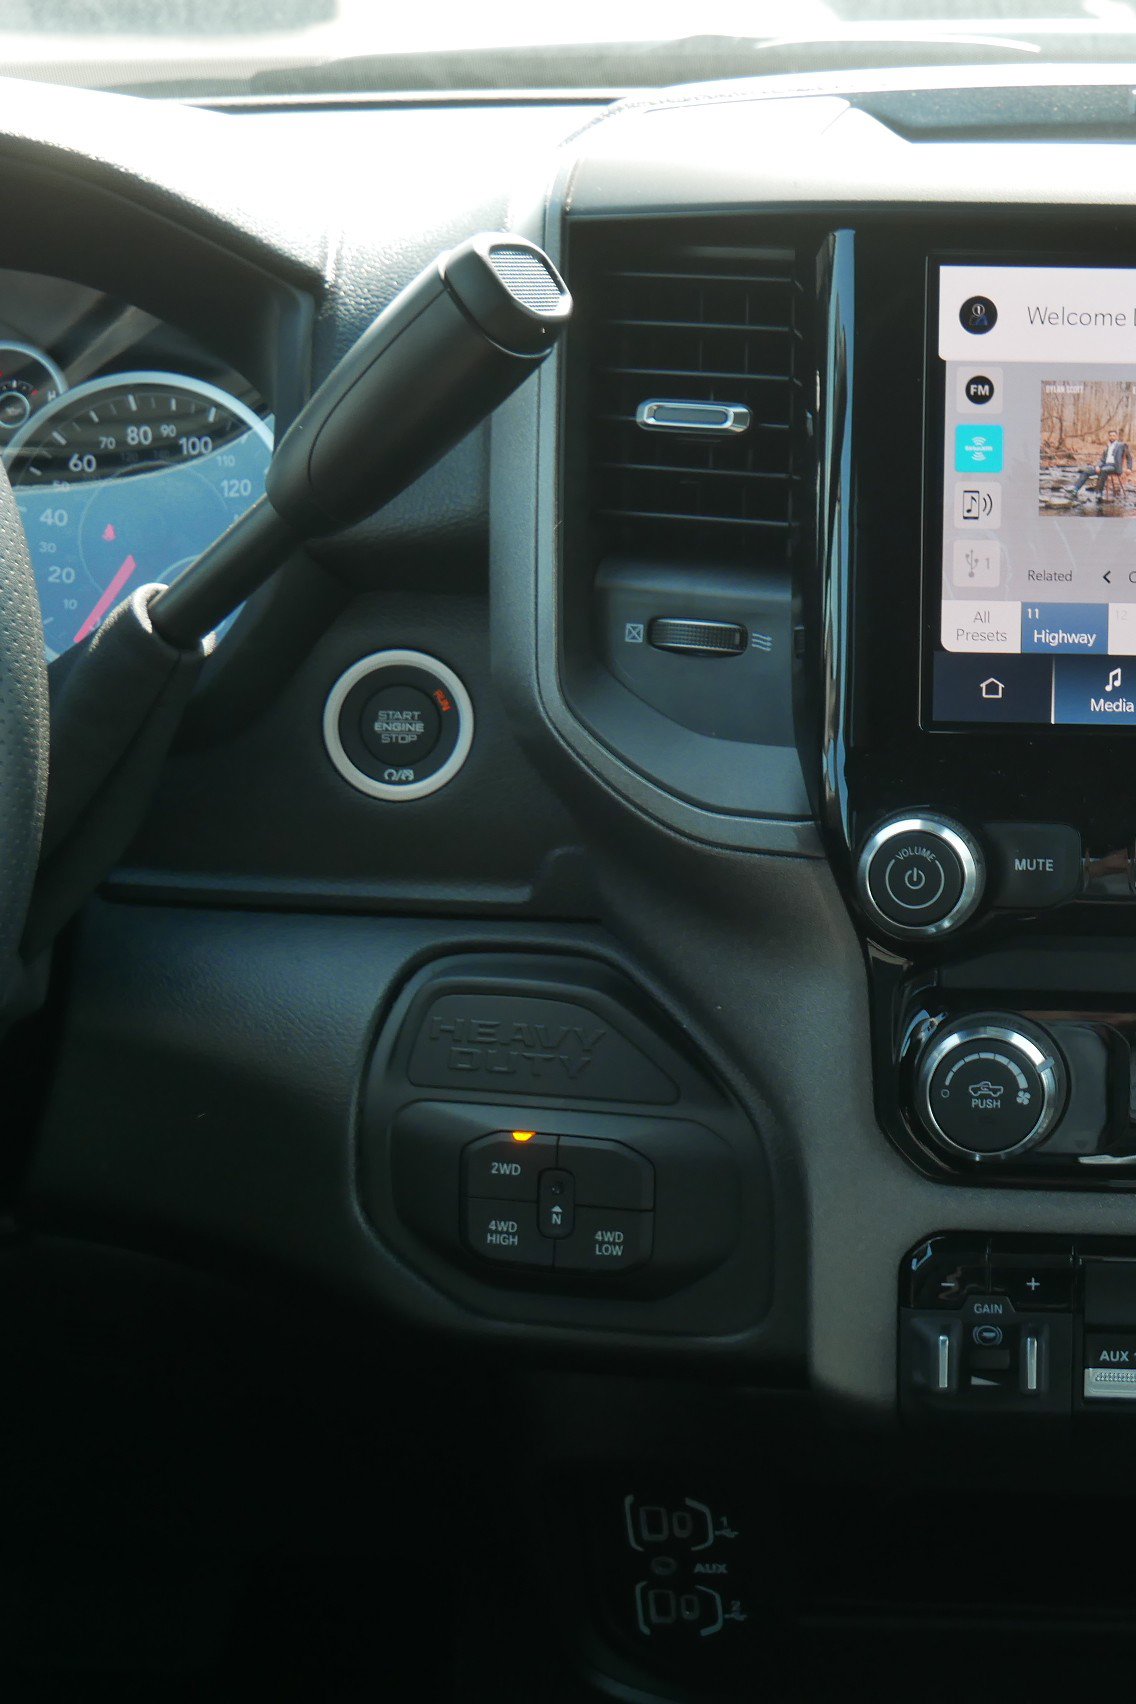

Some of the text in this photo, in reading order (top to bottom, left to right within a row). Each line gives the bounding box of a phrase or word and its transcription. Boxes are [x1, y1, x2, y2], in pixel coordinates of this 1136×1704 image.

[1027, 306, 1127, 327] Welcome
[970, 385, 990, 396] FM
[127, 426, 152, 445] 80
[160, 424, 177, 438] 90
[100, 437, 116, 450] 70
[179, 436, 212, 454] 100
[68, 454, 97, 472] 60
[216, 455, 236, 468] 110
[220, 479, 252, 498] 120
[39, 508, 69, 527] 40
[38, 542, 57, 554] 30
[48, 565, 76, 584] 20
[1027, 570, 1073, 582] Related
[63, 598, 78, 610] 10
[973, 611, 991, 623] All
[1027, 608, 1039, 619] 11
[956, 629, 1008, 642] Presets
[1033, 629, 1097, 646] Highway
[1090, 698, 1135, 712] Media
[378, 711, 421, 720] START
[374, 722, 424, 732] ENGINE
[381, 733, 417, 743] STOP
[895, 846, 936, 862] VOLUME
[1014, 858, 1054, 872] MUTE
[429, 1016, 607, 1051] HEAVY
[448, 1047, 591, 1078] DUTY
[971, 1098, 1001, 1109] PUSH
[491, 1162, 521, 1176] 2WD
[551, 1213, 562, 1225] N
[488, 1220, 518, 1233] 4WD
[487, 1233, 518, 1246] HIGH
[595, 1230, 624, 1243] 4WD
[595, 1243, 624, 1256] LOW
[974, 1302, 1003, 1314] GAIN
[1100, 1350, 1129, 1362] AUX
[694, 1563, 728, 1573] AUX
